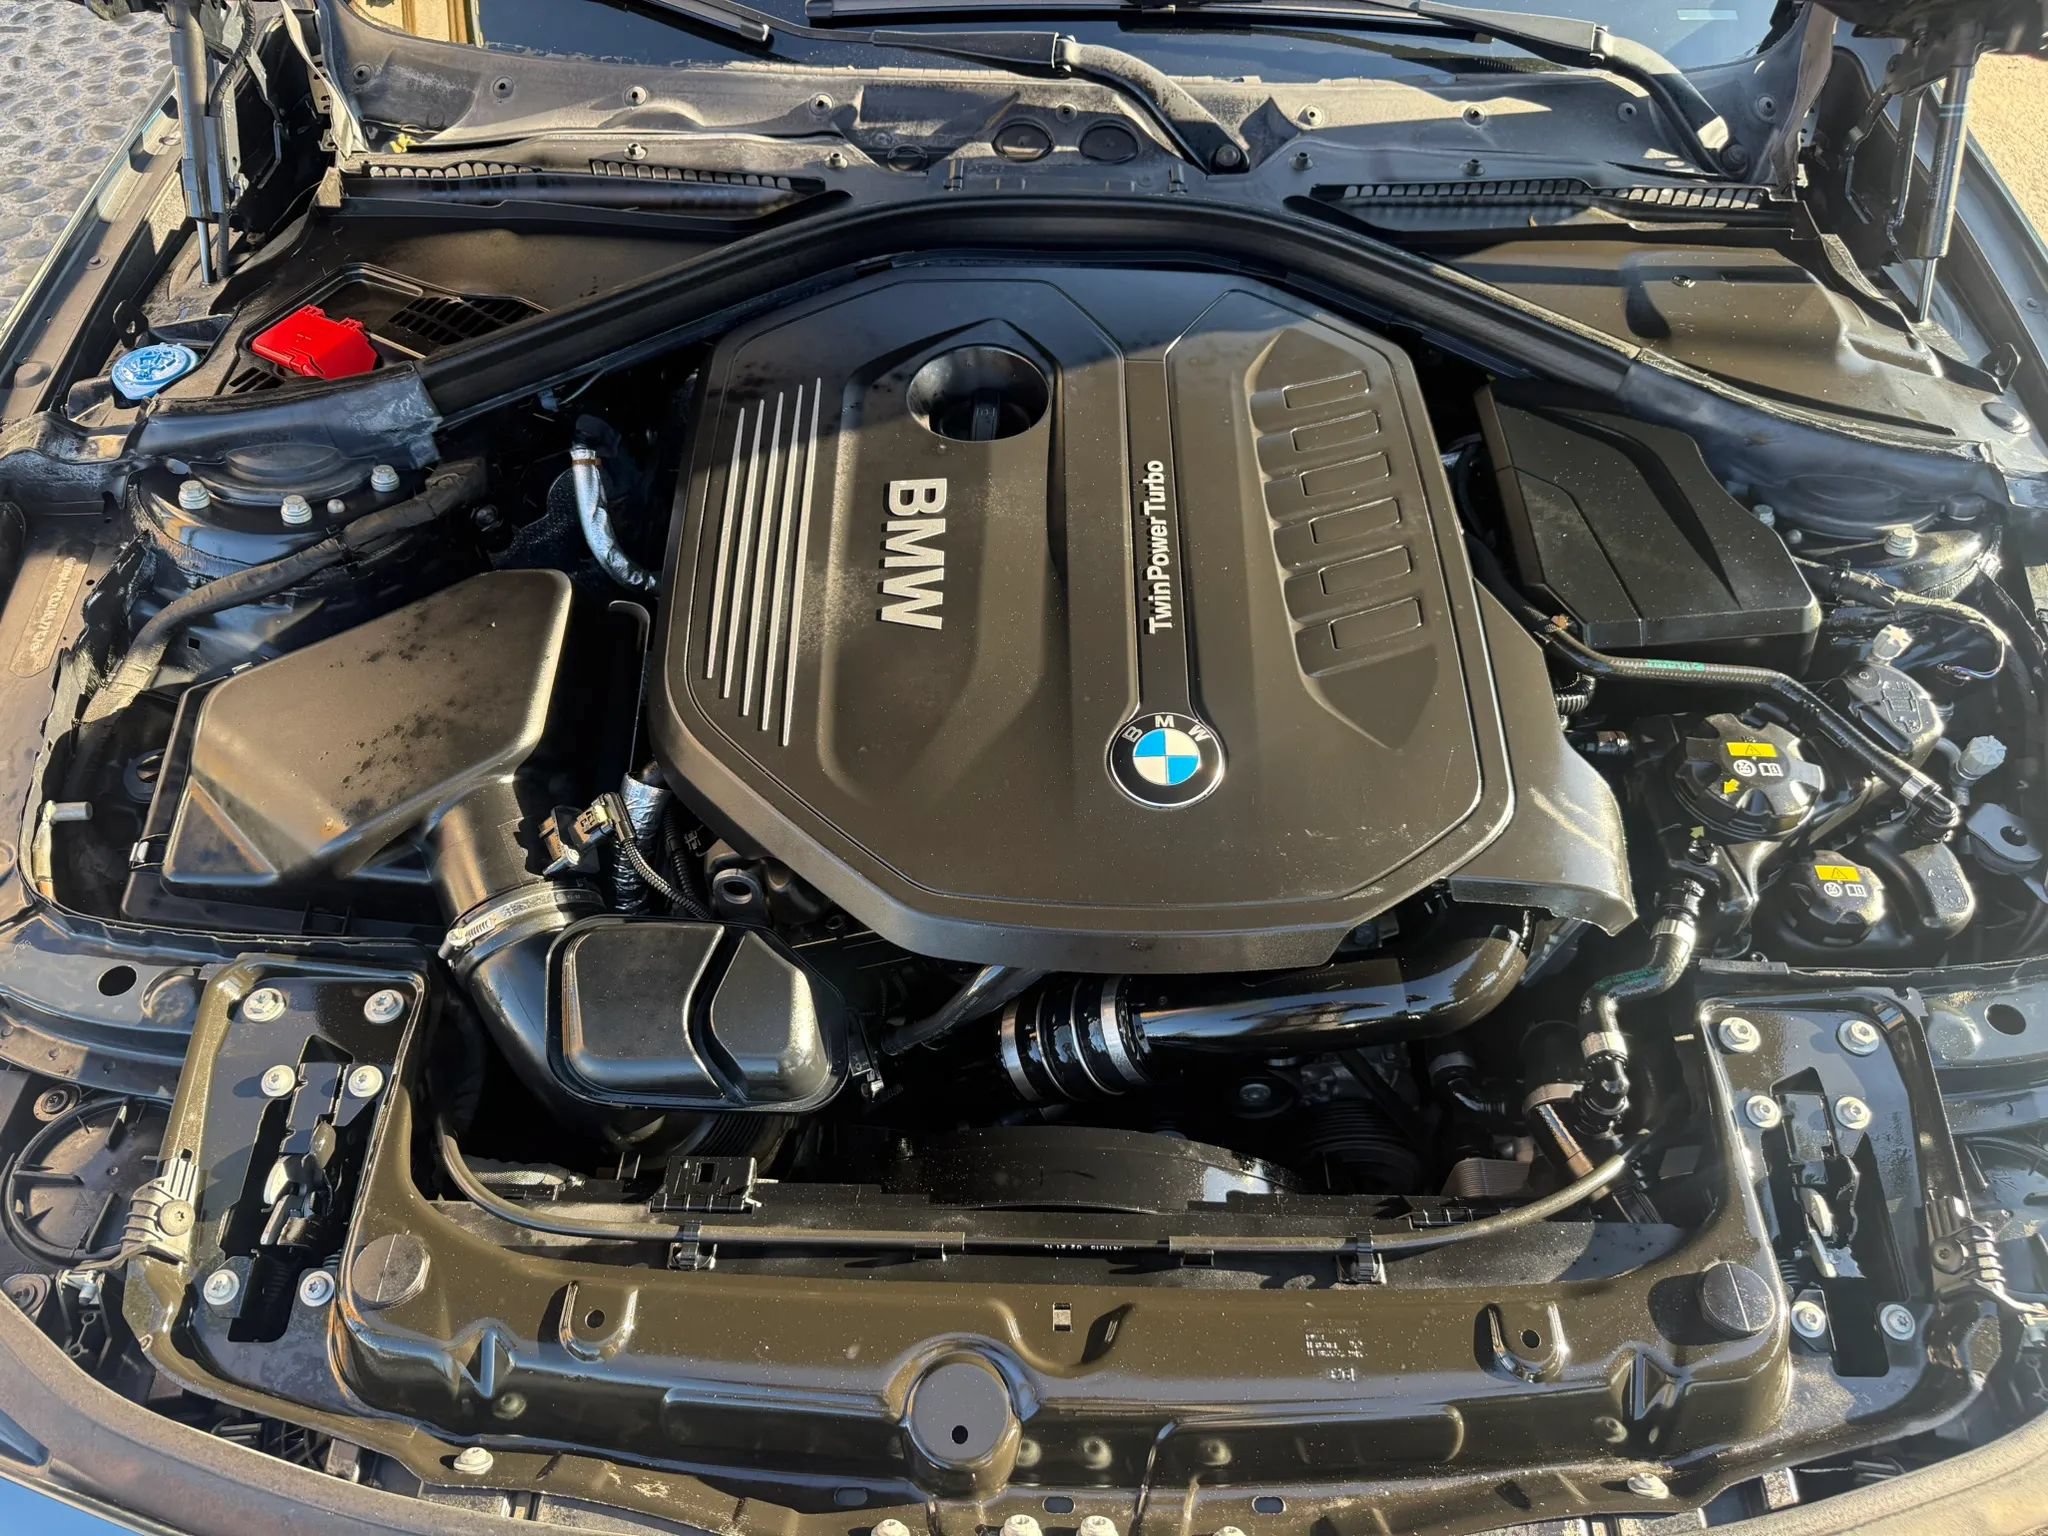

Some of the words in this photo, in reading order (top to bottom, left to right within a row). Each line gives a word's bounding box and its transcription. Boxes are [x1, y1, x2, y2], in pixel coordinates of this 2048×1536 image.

[1143, 460, 1165, 516] Turbo
[881, 478, 947, 630] BMW
[1147, 517, 1173, 634] TwinPower
[1122, 715, 1211, 743] BMW
